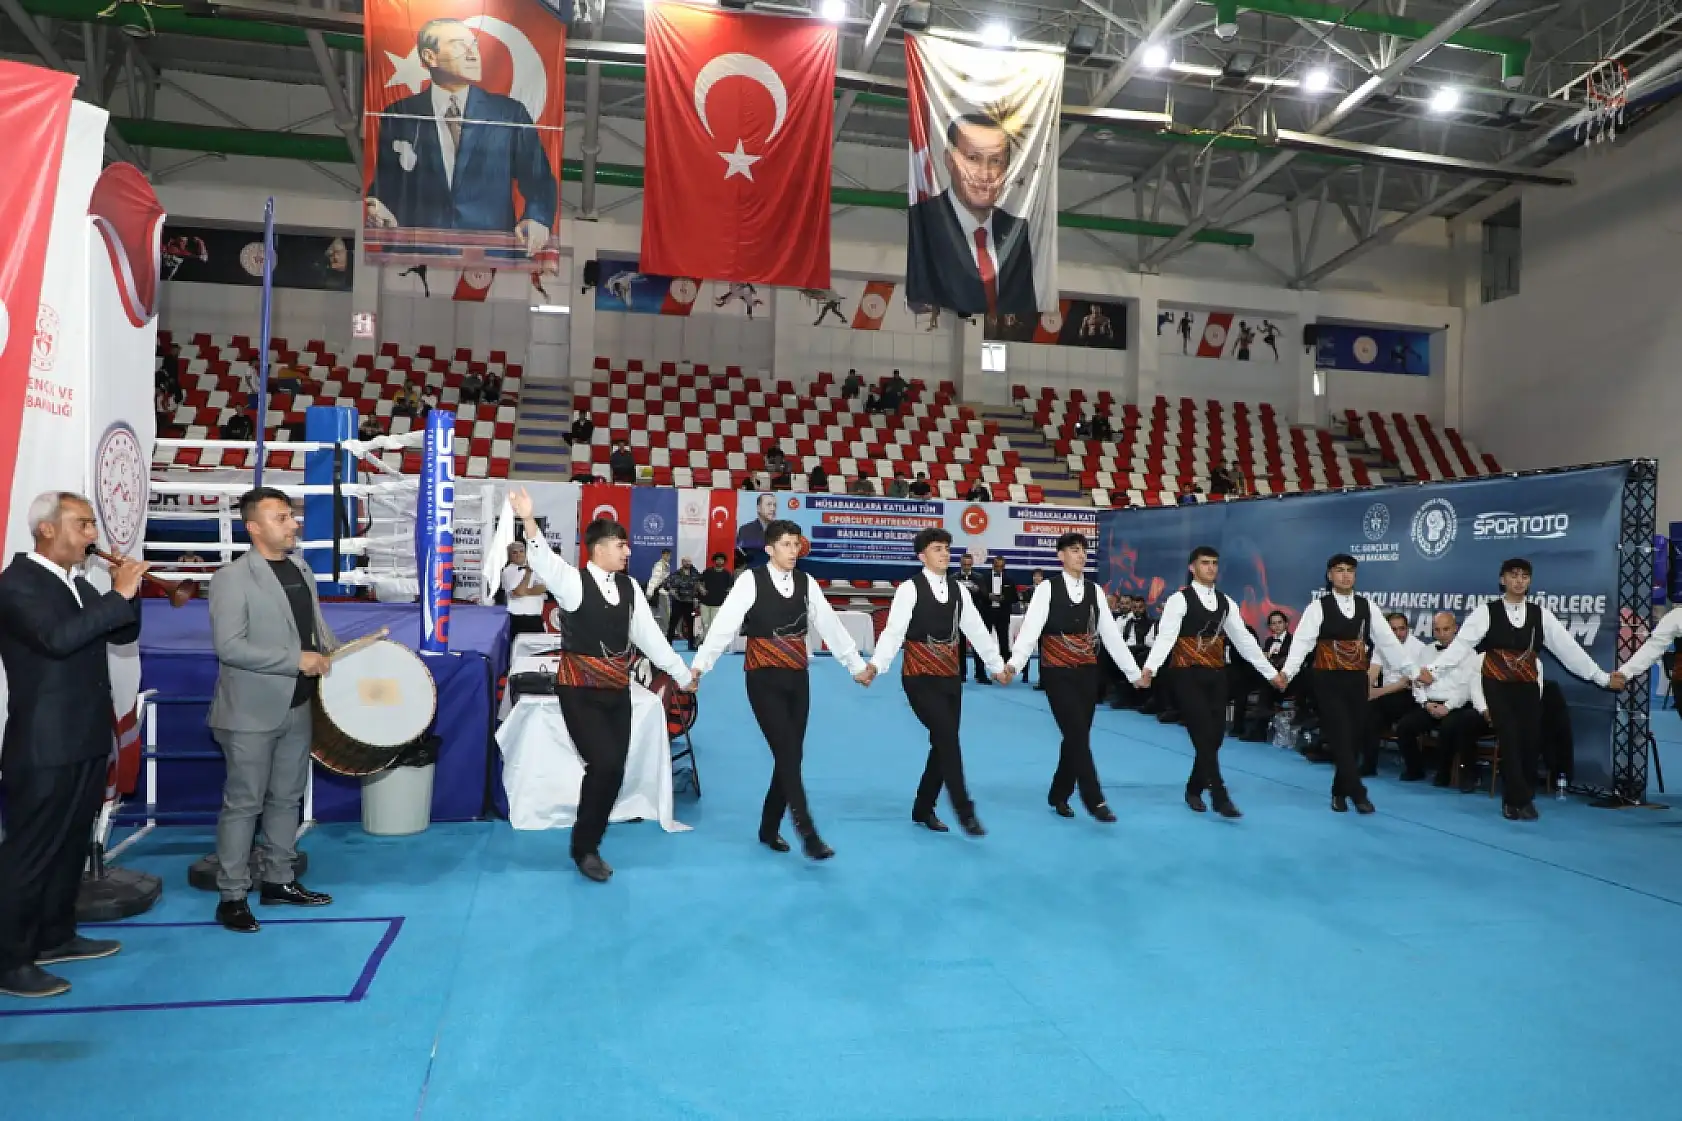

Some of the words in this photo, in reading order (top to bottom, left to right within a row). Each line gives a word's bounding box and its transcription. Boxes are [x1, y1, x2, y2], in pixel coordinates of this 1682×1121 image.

[919, 503, 936, 514] TÜM
[1389, 590, 1441, 609] HAKEM
[1443, 592, 1464, 611] VE
